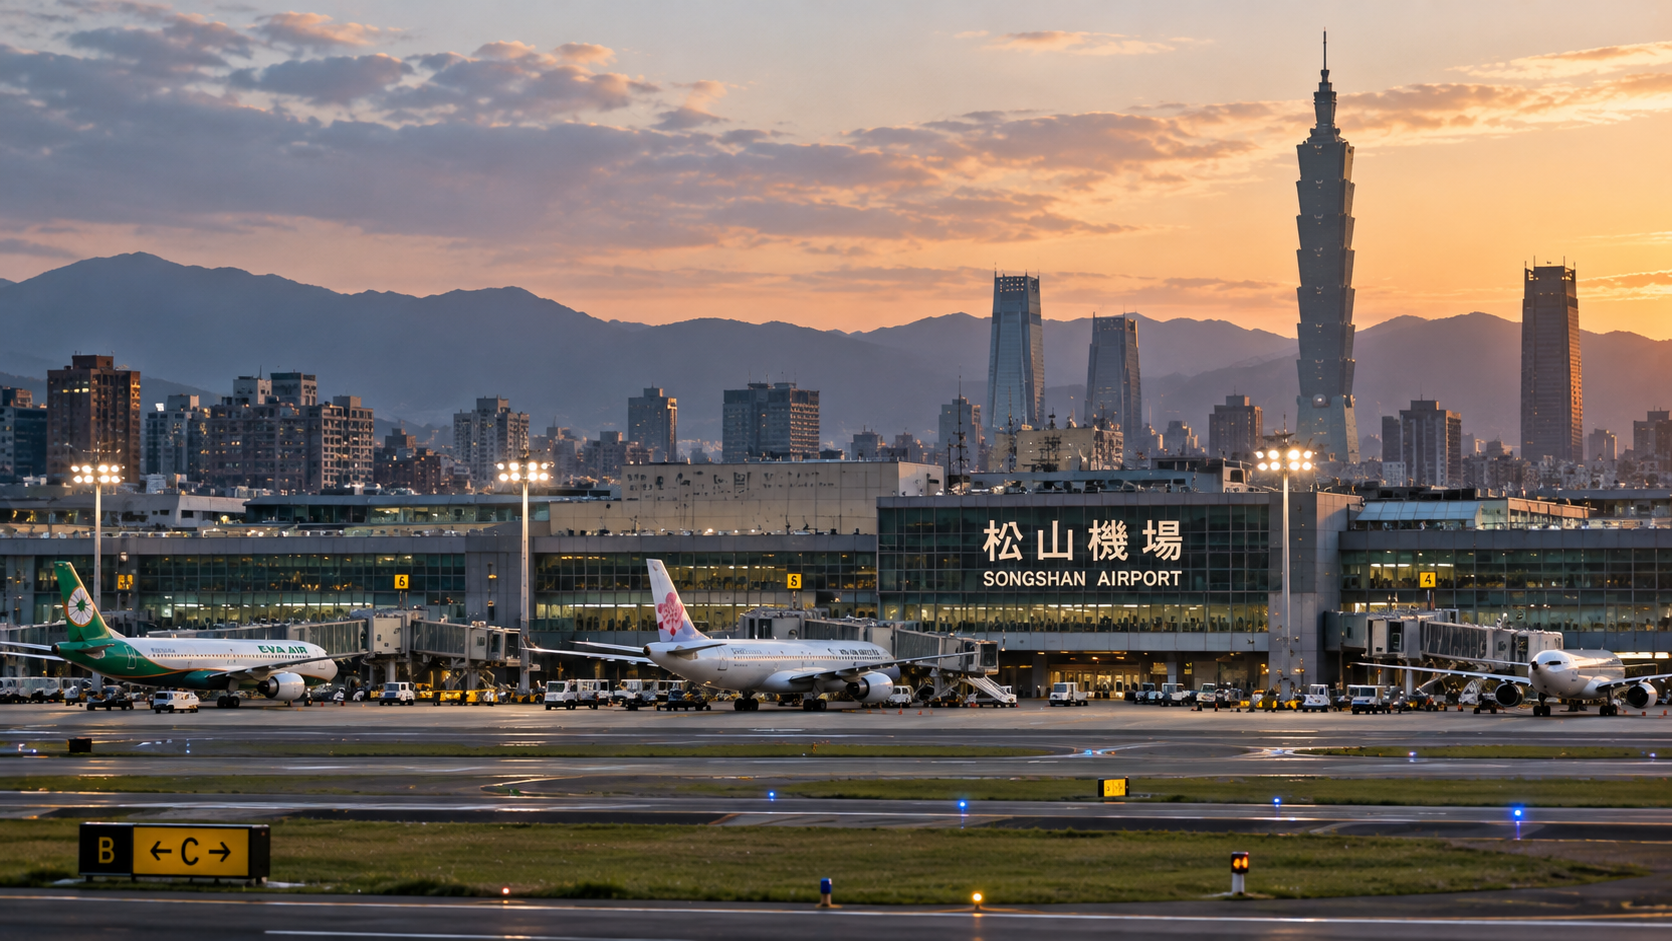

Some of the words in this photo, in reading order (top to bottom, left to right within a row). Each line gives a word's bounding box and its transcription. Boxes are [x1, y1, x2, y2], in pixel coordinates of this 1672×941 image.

[982, 519, 1183, 562] 松山機場
[399, 576, 406, 587] 6
[983, 570, 1086, 587] SONGSHAN
[1097, 570, 1183, 587] AIRPORT
[1425, 574, 1432, 585] 4
[258, 645, 286, 654] EVA
[288, 645, 308, 654] AIR
[98, 836, 115, 864] B
[180, 837, 200, 866] C
